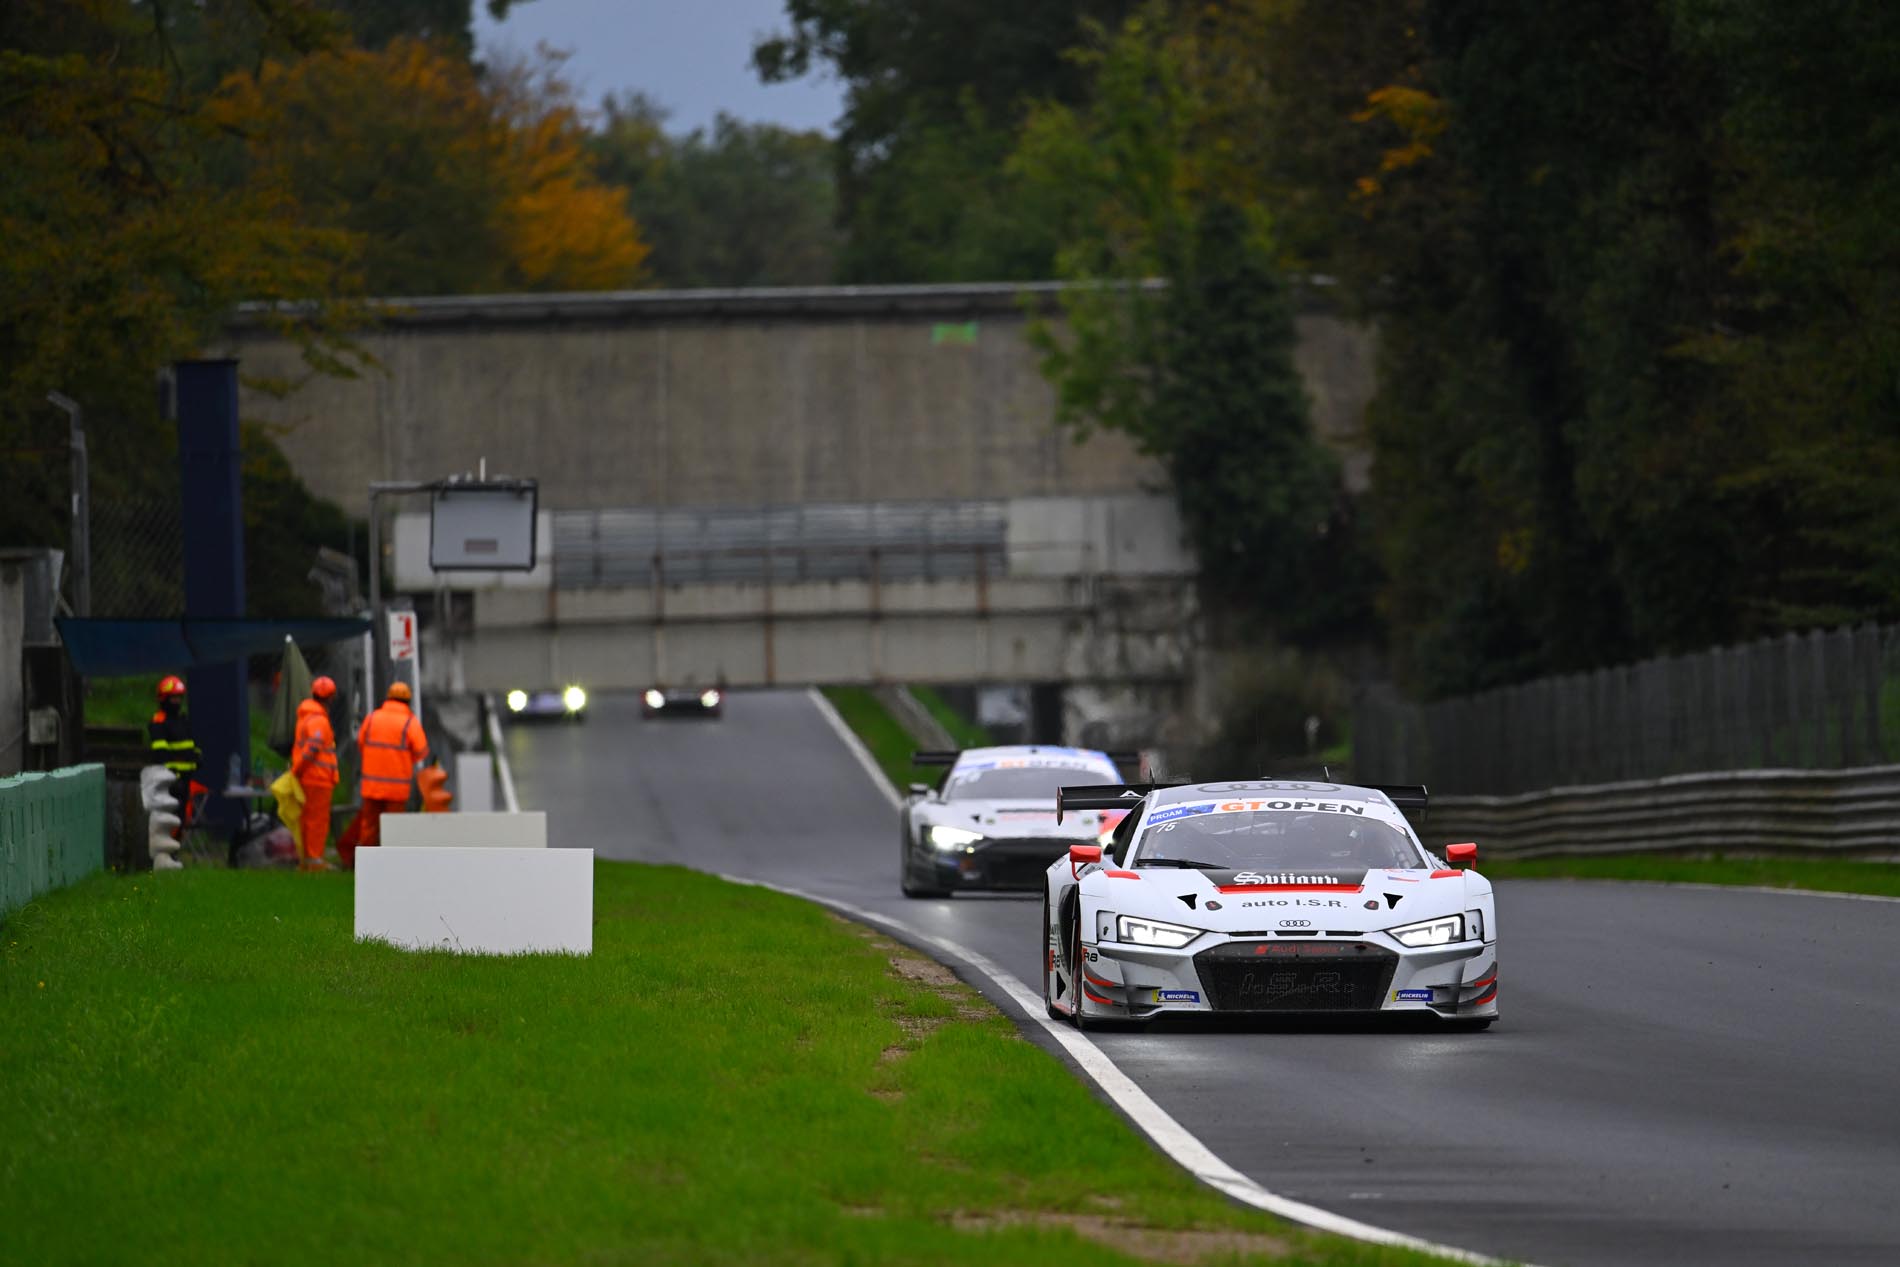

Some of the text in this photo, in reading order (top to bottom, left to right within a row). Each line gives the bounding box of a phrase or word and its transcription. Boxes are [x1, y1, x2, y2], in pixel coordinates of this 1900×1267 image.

[1150, 810, 1183, 822] PROAM
[1156, 822, 1178, 833] 75
[1242, 899, 1348, 909] auto I.S.R.
